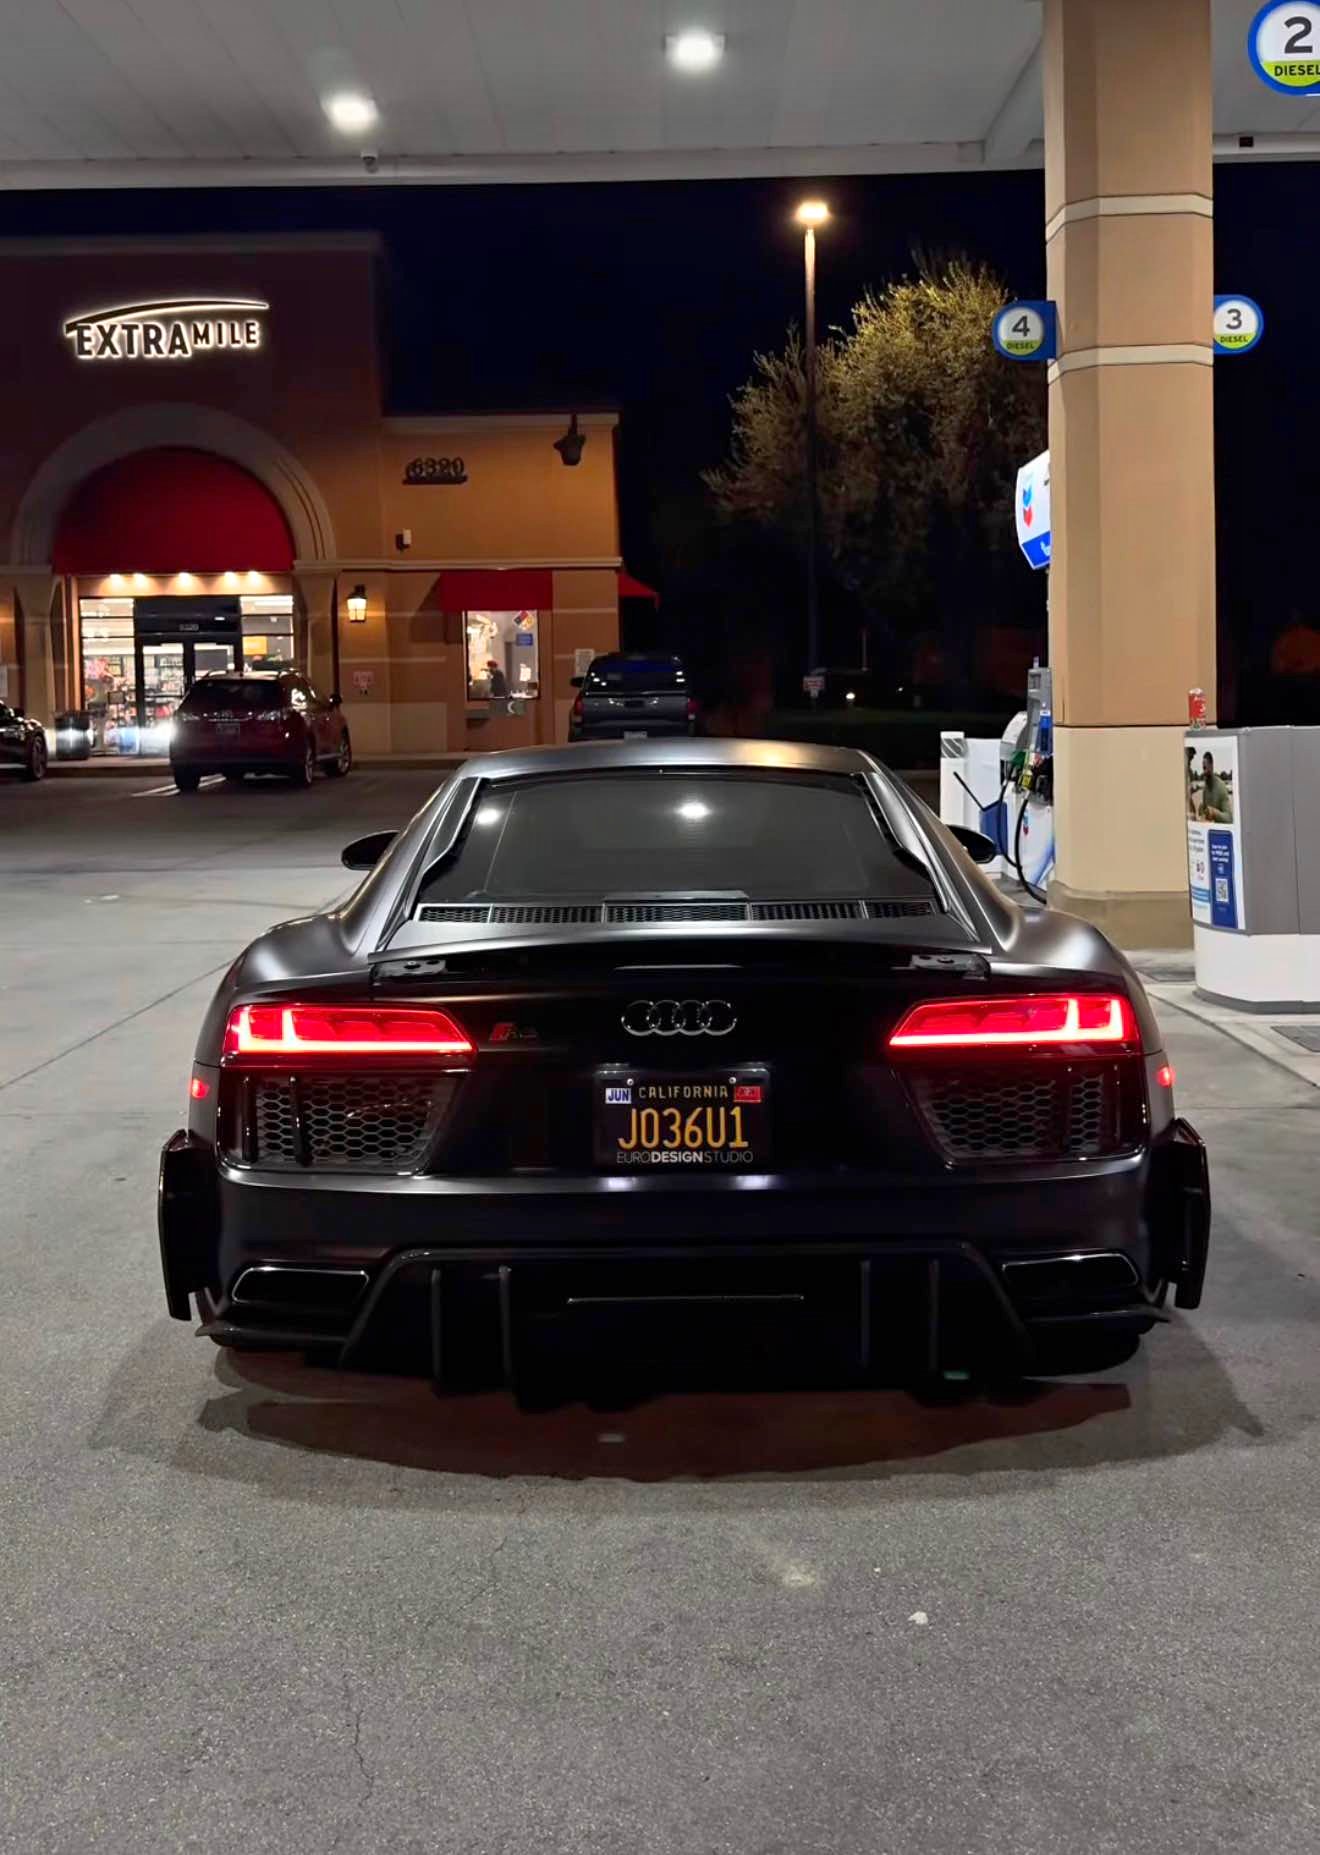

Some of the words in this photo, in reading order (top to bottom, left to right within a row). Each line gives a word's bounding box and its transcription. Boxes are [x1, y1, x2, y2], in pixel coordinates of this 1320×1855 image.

[1284, 16, 1313, 54] 2
[1274, 65, 1320, 77] DIESEL
[1012, 315, 1030, 337] 4
[1226, 308, 1242, 330] 3
[76, 321, 259, 356] EXTRAMILE
[1007, 341, 1035, 350] DIESEL
[1220, 335, 1248, 343] DIESEL
[607, 1089, 630, 1101] JUN
[639, 1085, 729, 1099] CALIFORNIA
[617, 1106, 749, 1149] J036U1
